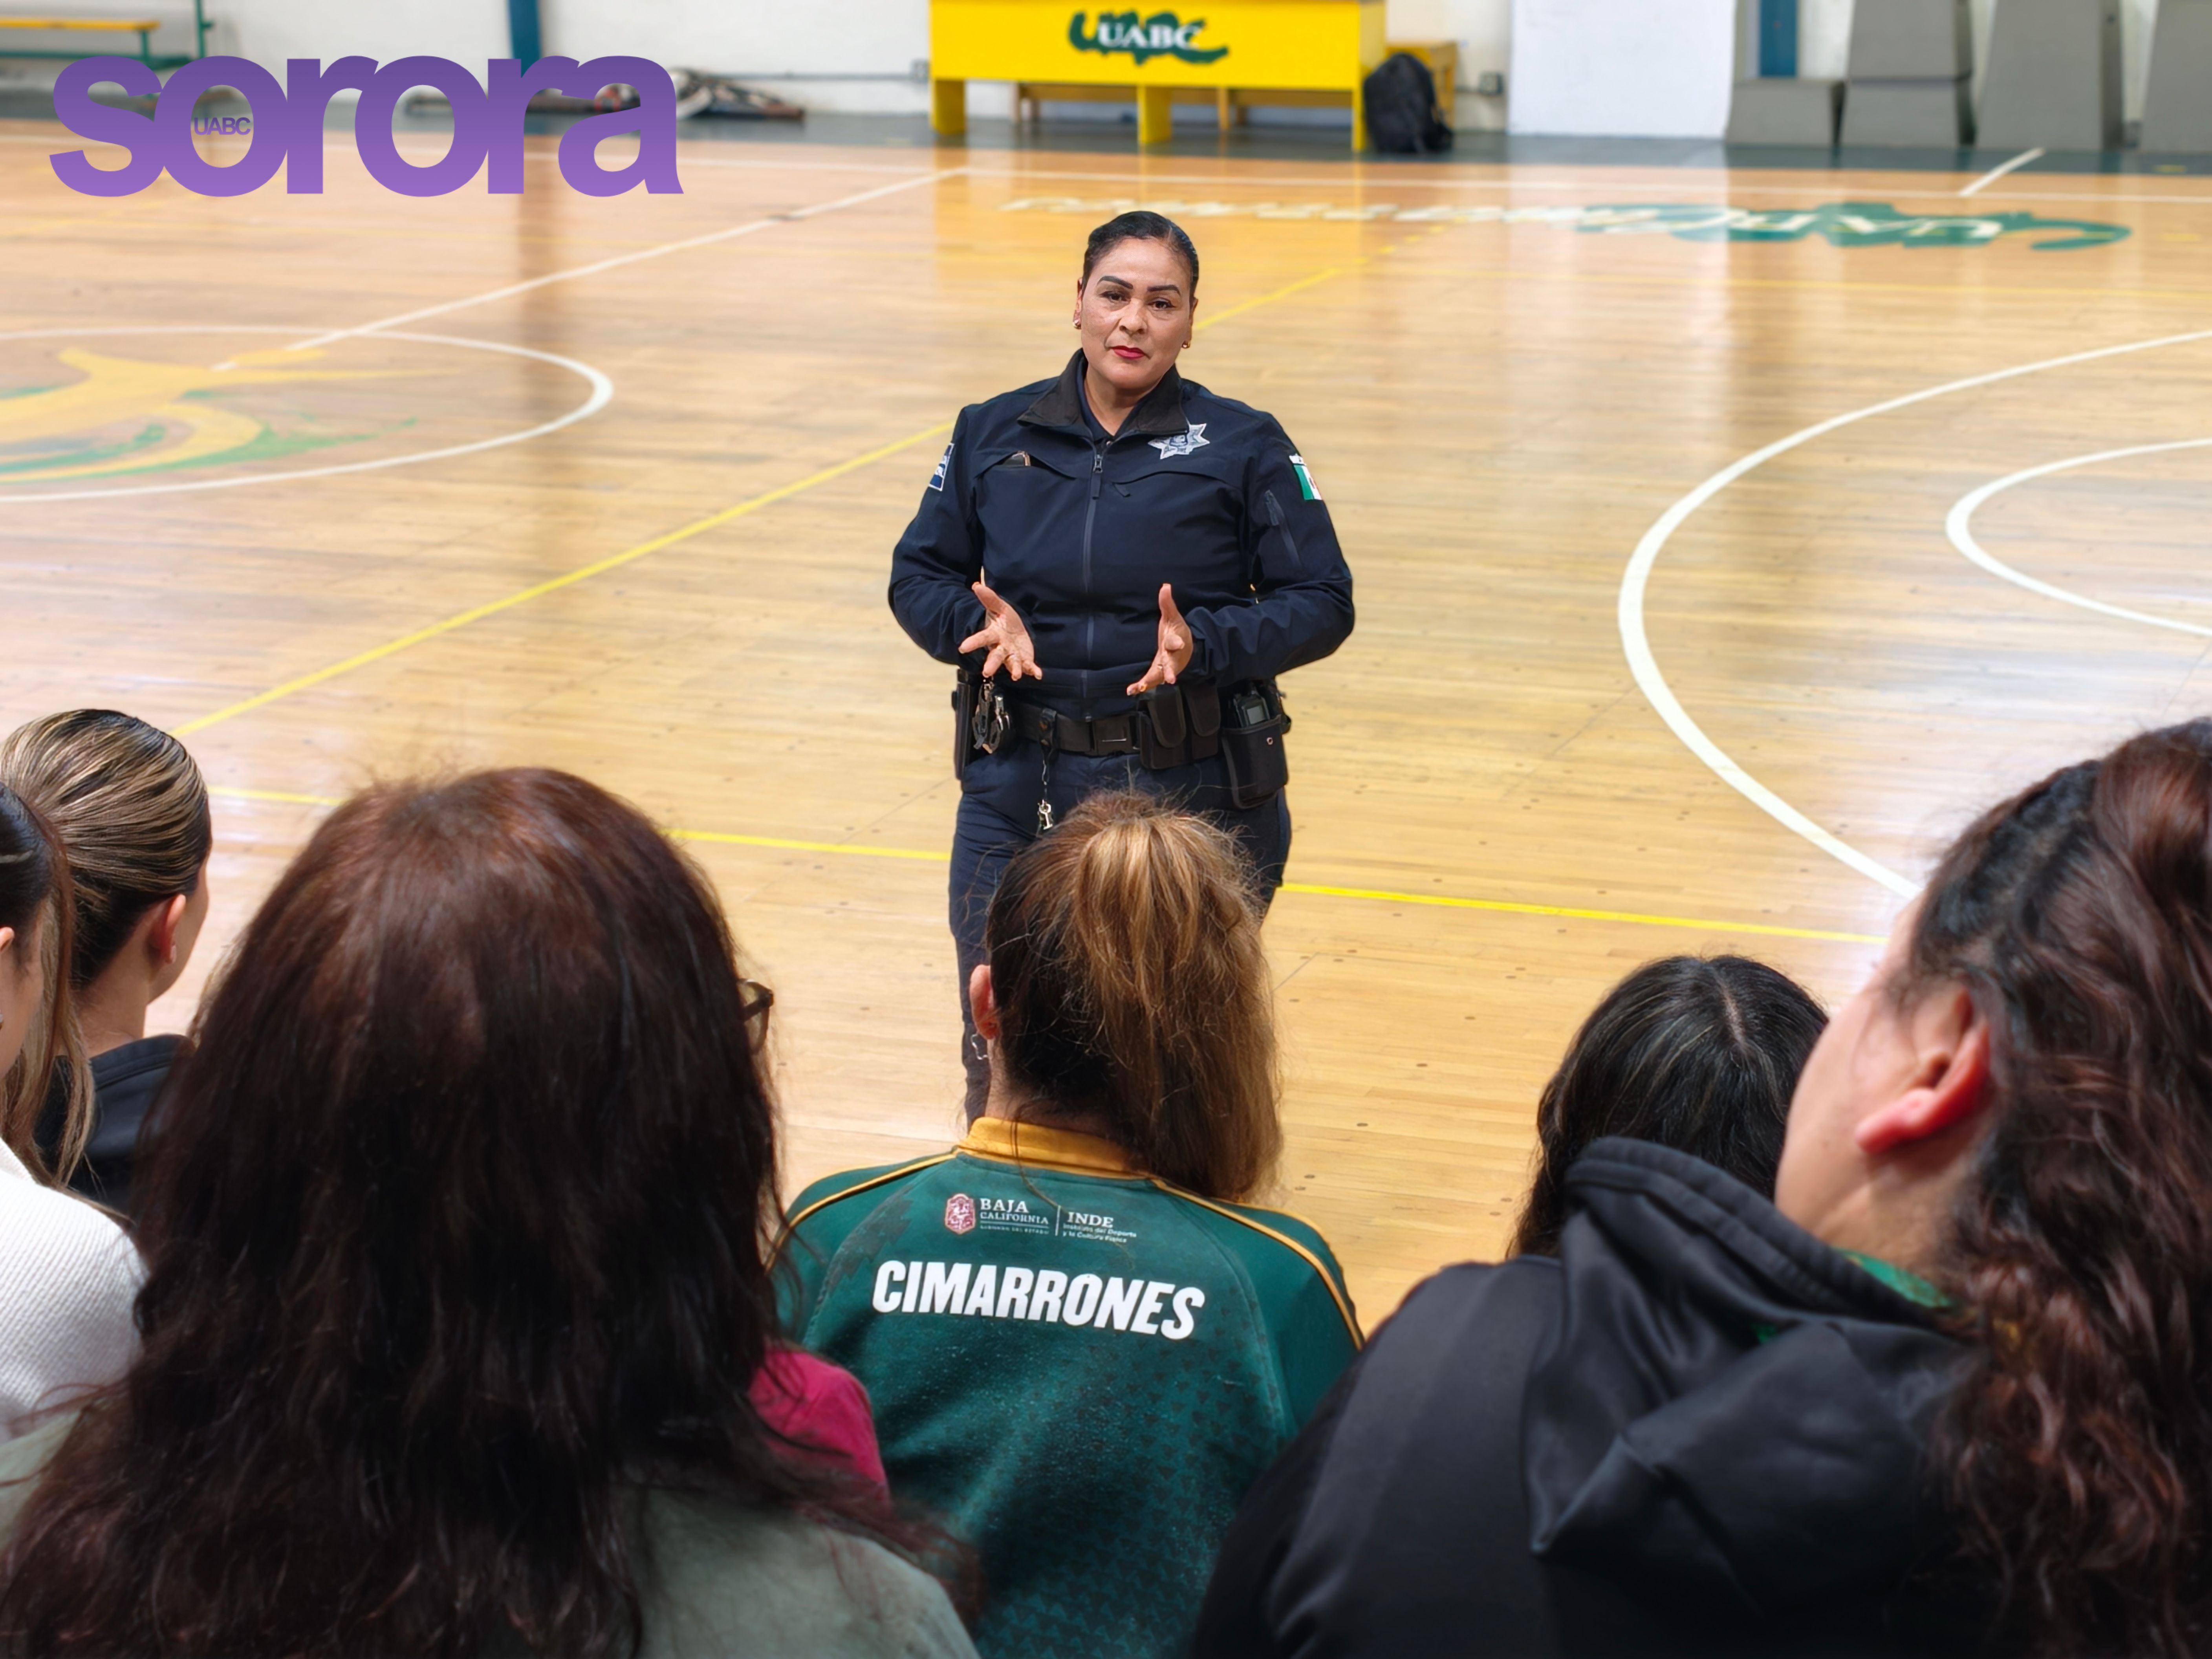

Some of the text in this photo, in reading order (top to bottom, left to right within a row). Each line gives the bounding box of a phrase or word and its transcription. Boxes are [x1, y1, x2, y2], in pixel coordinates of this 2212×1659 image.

[980, 1198, 1029, 1213] BAJA
[980, 1212, 1049, 1225] CALIFORNIA
[1067, 1211, 1114, 1229] INDE
[872, 1260, 1205, 1340] CIMARRONES
